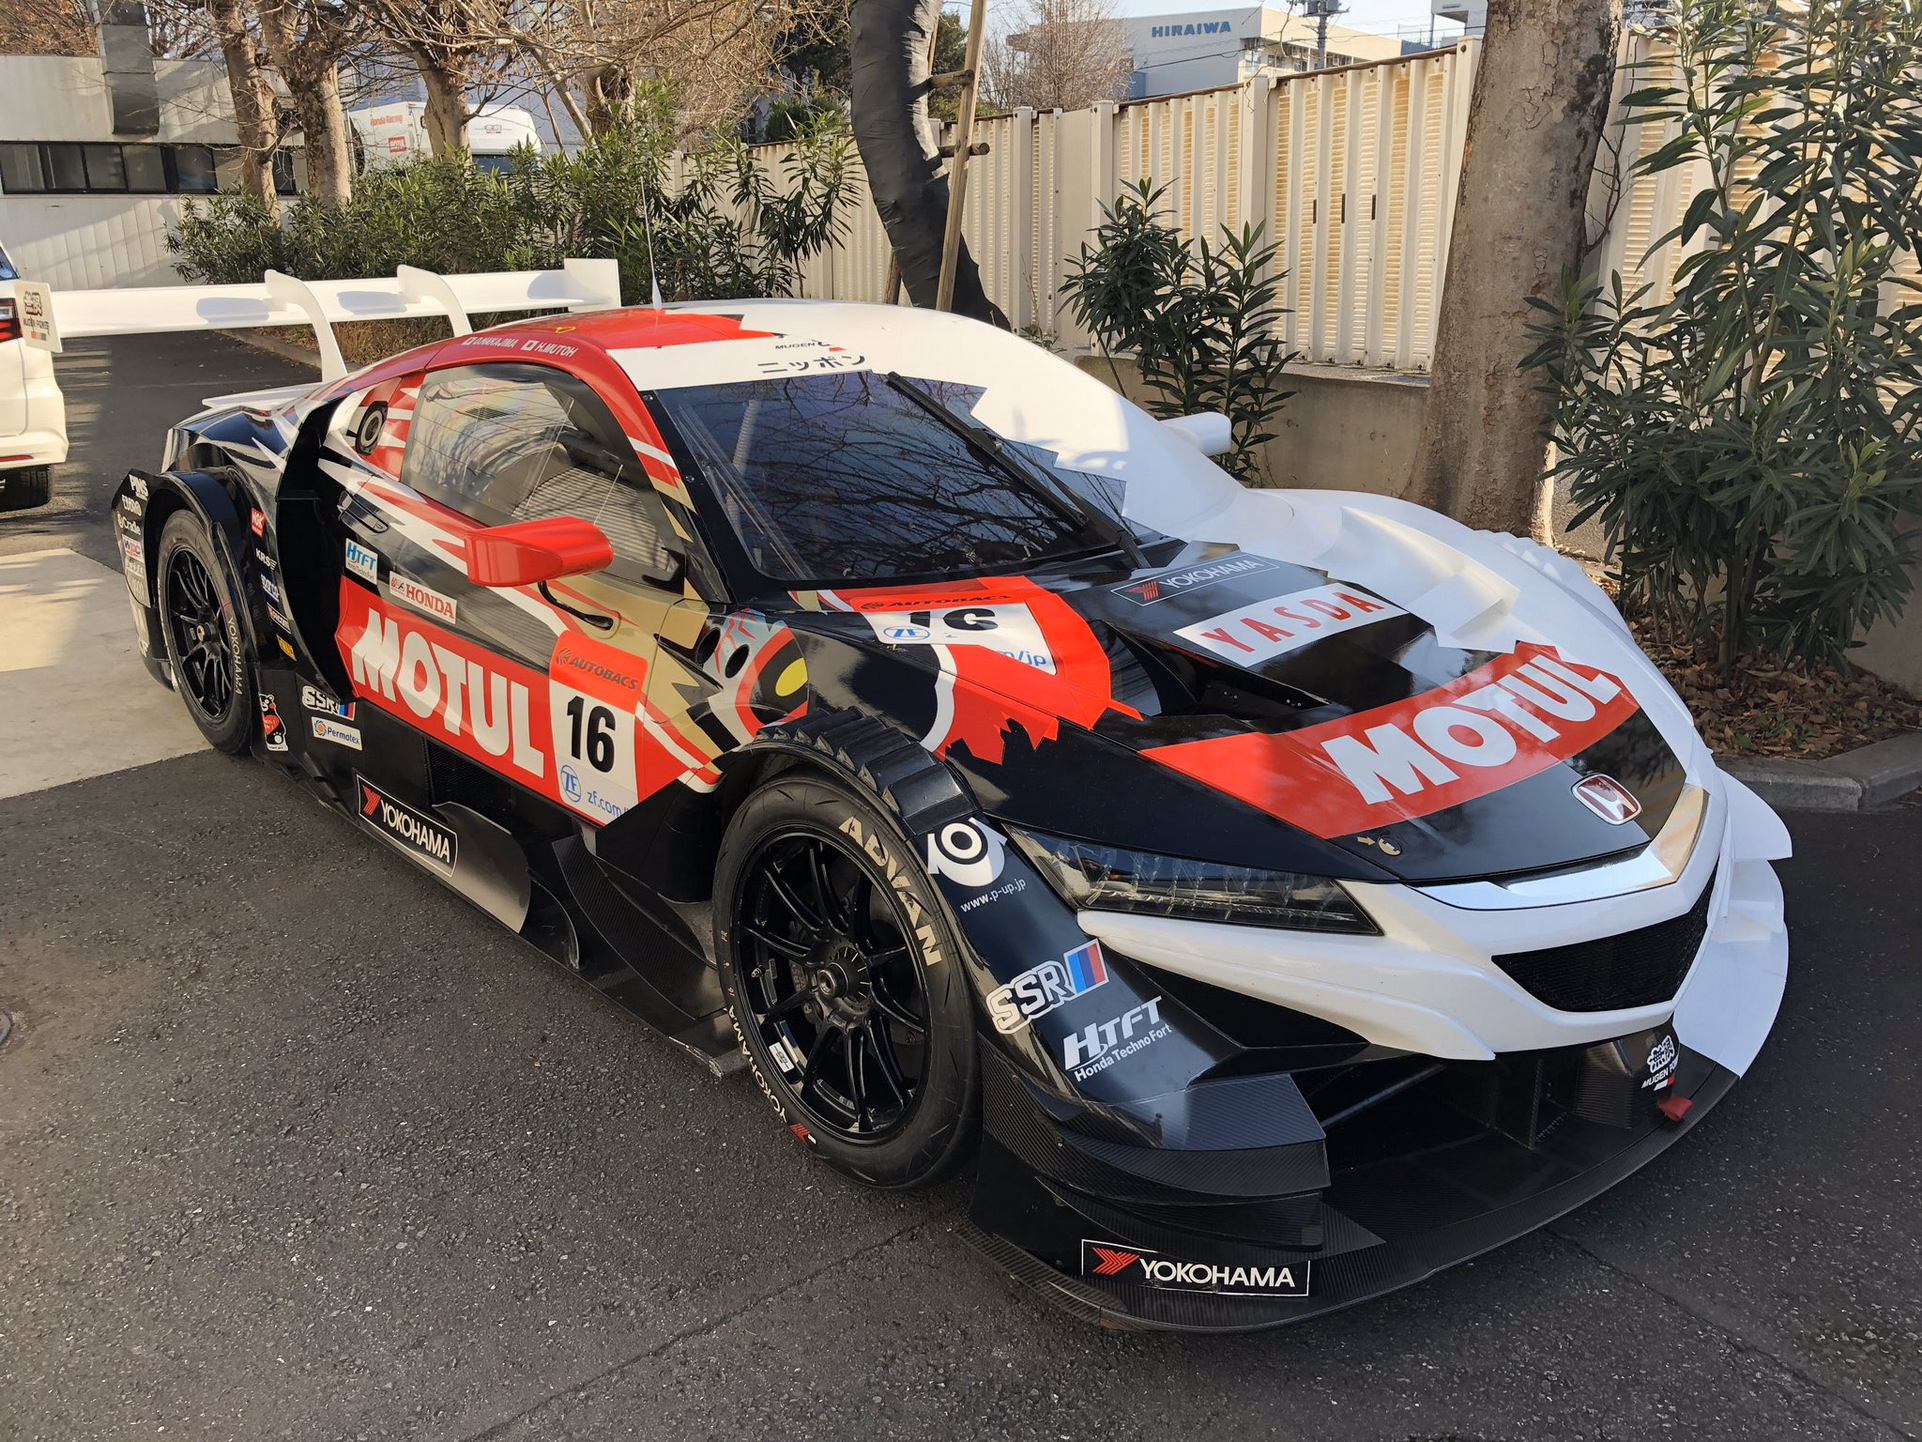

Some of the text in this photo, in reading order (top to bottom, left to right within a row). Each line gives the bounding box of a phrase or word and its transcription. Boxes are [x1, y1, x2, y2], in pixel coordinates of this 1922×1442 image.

[1151, 21, 1232, 38] HIRAIWA
[535, 341, 578, 357] H.MUTOH
[775, 342, 815, 350] MUGEN
[757, 355, 866, 374] ニッポン
[256, 548, 271, 567] KRS
[346, 542, 376, 571] HTFT
[1160, 559, 1264, 589] YOKOHAMA
[405, 583, 455, 619] HONDA
[1200, 591, 1385, 653] YASDA
[228, 616, 243, 695] YOKOHAMA
[569, 655, 639, 690] AUTOBACS
[352, 607, 544, 779] MOTUL
[327, 727, 361, 745] Permatex
[567, 695, 616, 773] 16
[1320, 654, 1622, 805] MOTUL
[380, 799, 450, 863] YOKOHAMA
[838, 816, 942, 966] ADVAN
[960, 878, 1027, 913] www.p-up.jp
[987, 961, 1077, 1034] SSR
[1063, 996, 1162, 1070] HTFT
[728, 1004, 788, 1124] YOKOHAMA
[1074, 1056, 1115, 1082] Honda
[1641, 1068, 1668, 1089] MUGEN
[1139, 1258, 1296, 1287] YOKOHAMA
